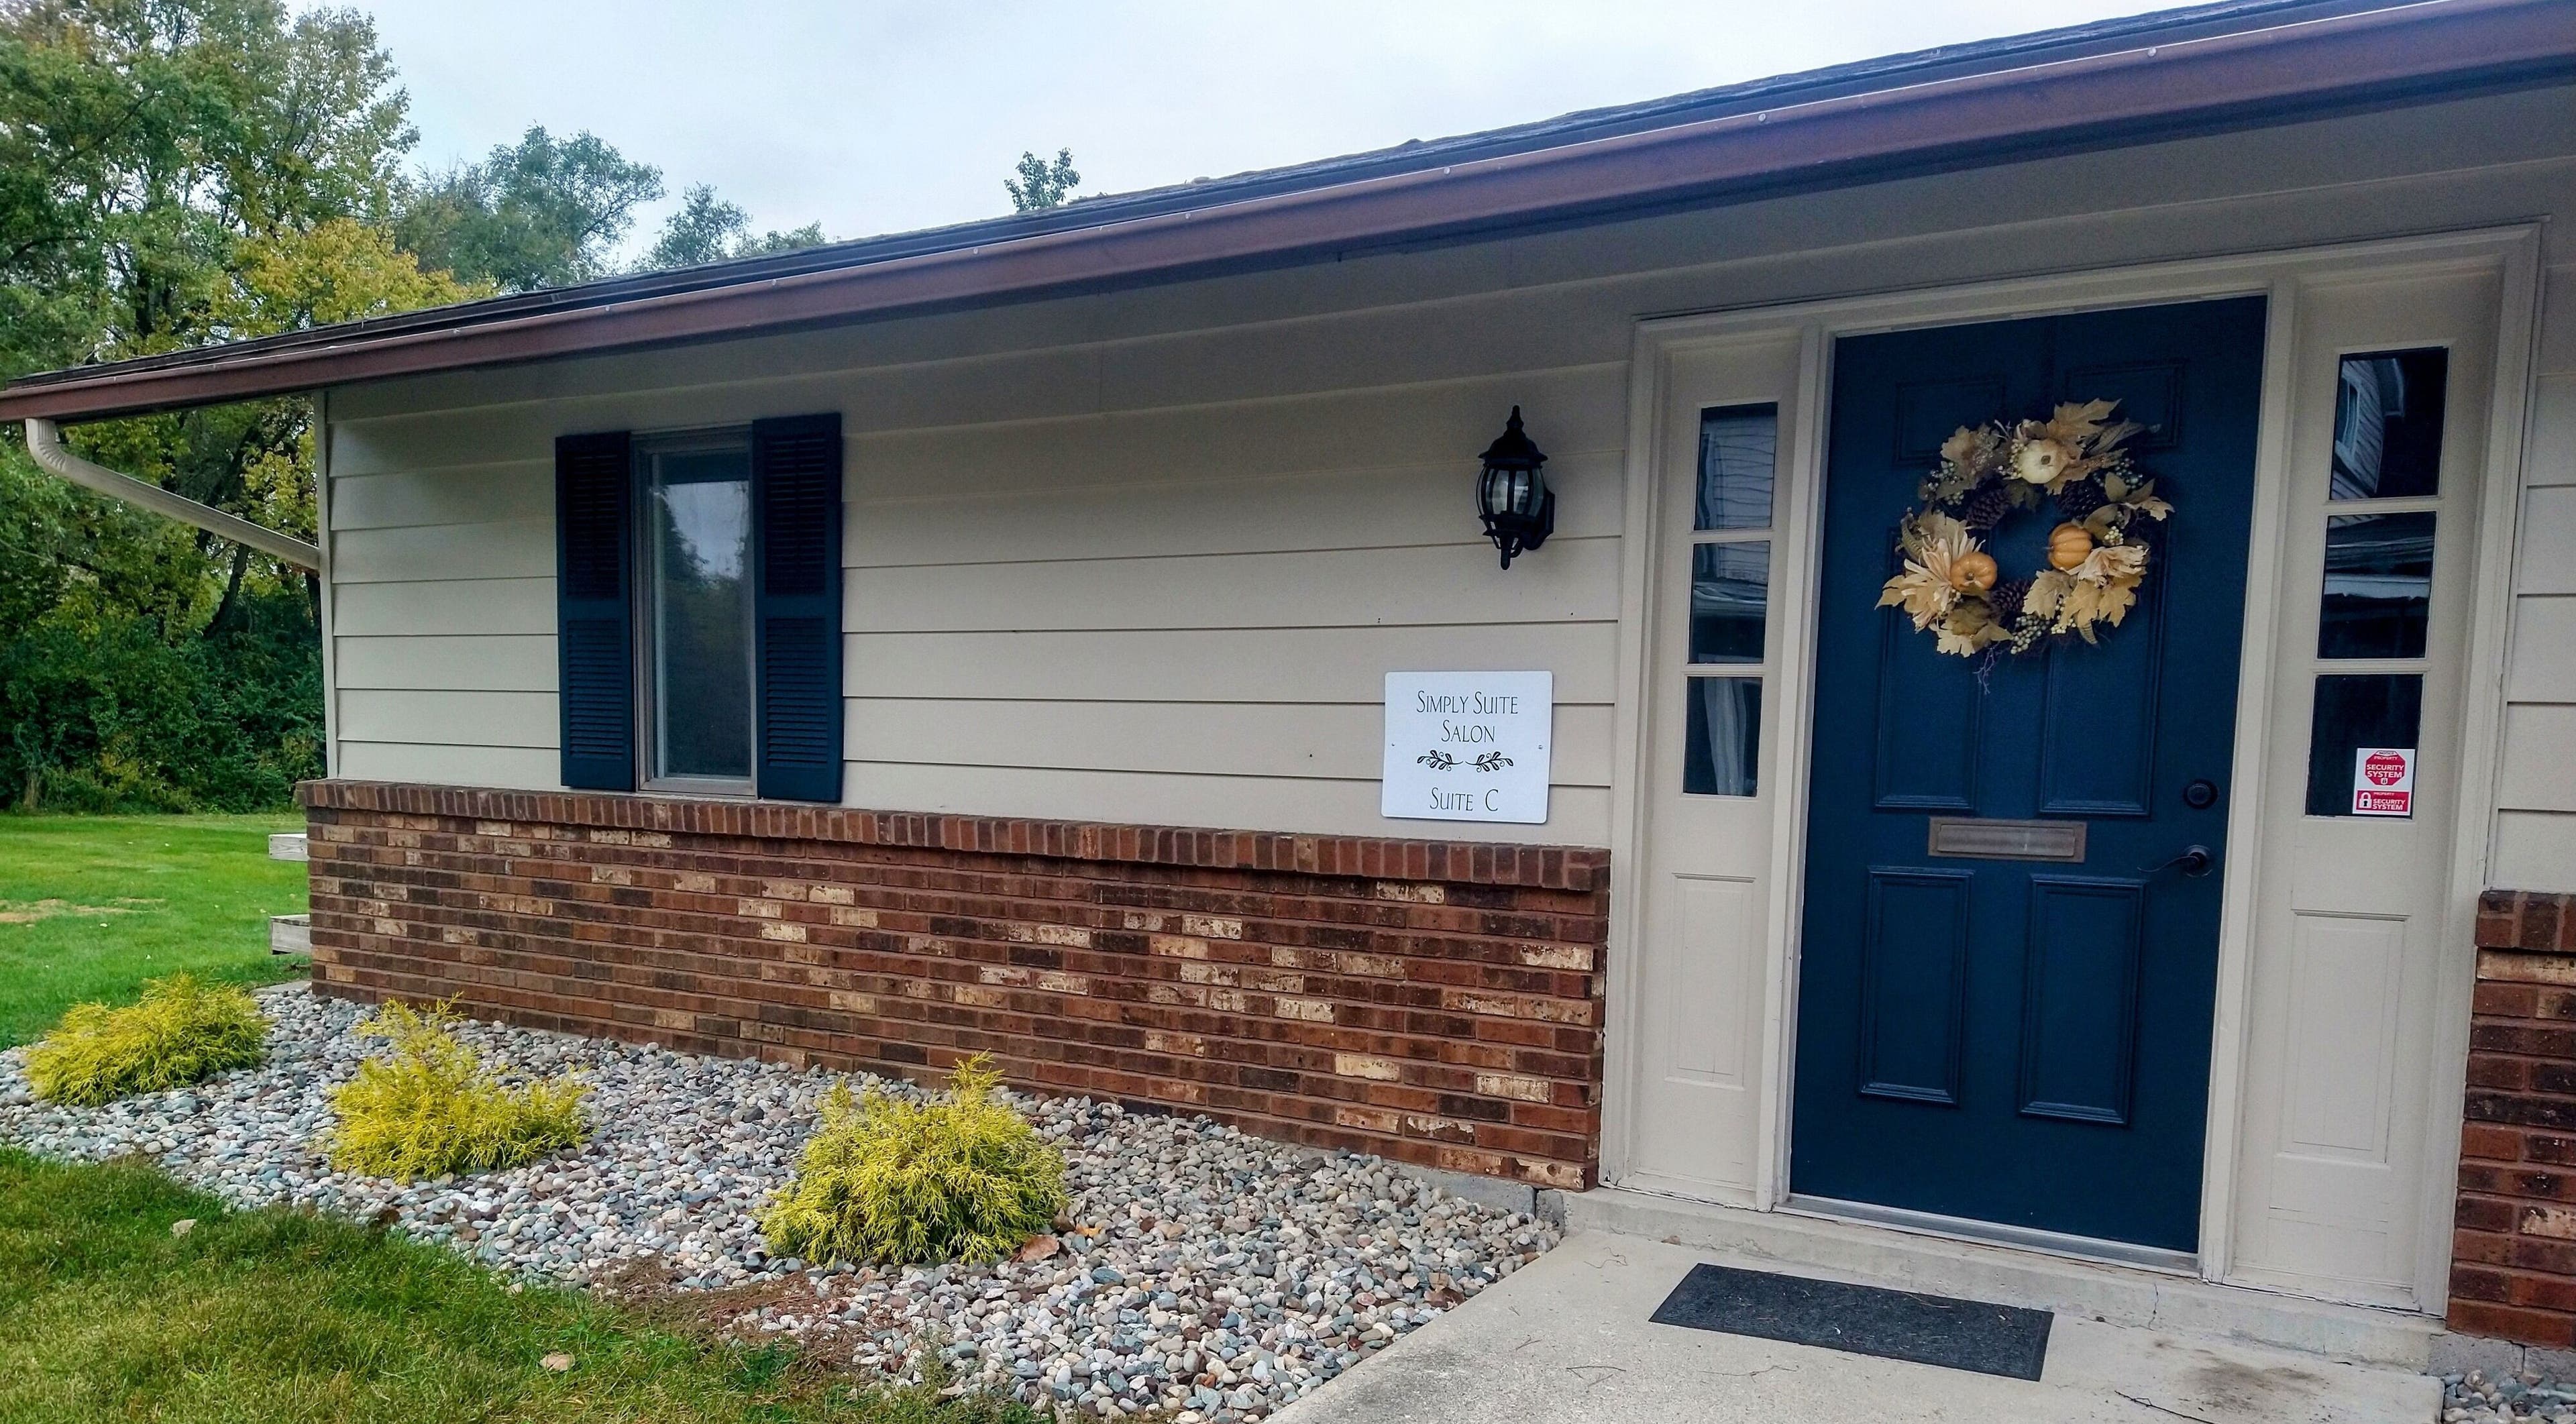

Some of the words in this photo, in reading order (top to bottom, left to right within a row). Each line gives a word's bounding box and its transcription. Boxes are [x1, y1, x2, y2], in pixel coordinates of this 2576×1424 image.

[1416, 690, 1469, 714] SIMPLY
[1472, 691, 1519, 714] SUITE
[1440, 719, 1495, 743] SALON
[1429, 787, 1474, 812] SUITE
[1485, 789, 1499, 812] C
